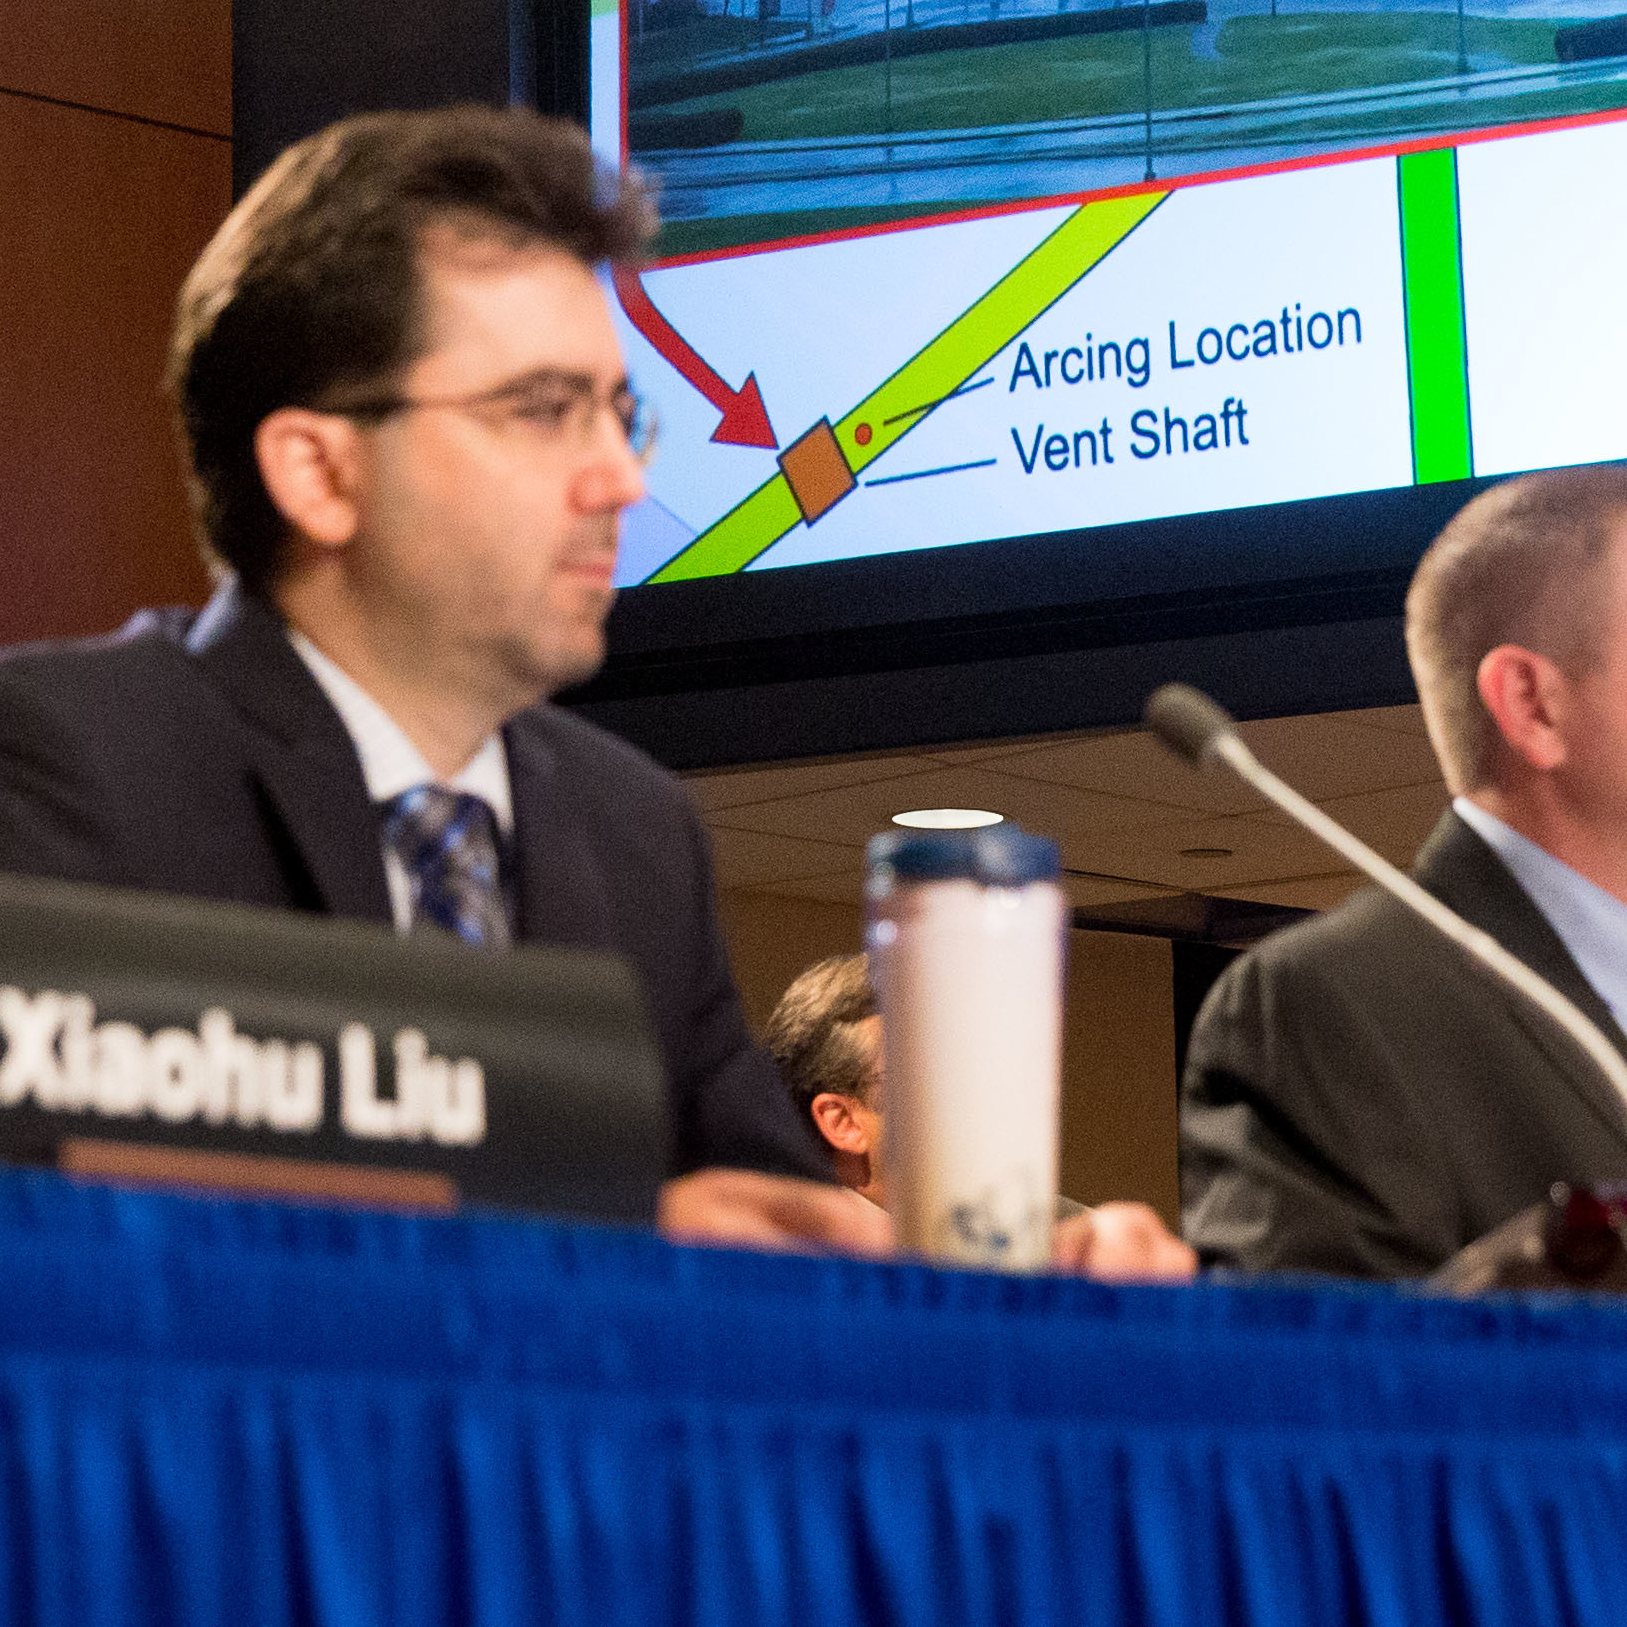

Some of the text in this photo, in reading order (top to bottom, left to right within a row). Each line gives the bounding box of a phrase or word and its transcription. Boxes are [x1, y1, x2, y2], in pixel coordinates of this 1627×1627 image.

[1009, 303, 1362, 391] Arcing Location
[1011, 398, 1249, 474] Vent Shaft
[339, 1023, 485, 1145] Liu
